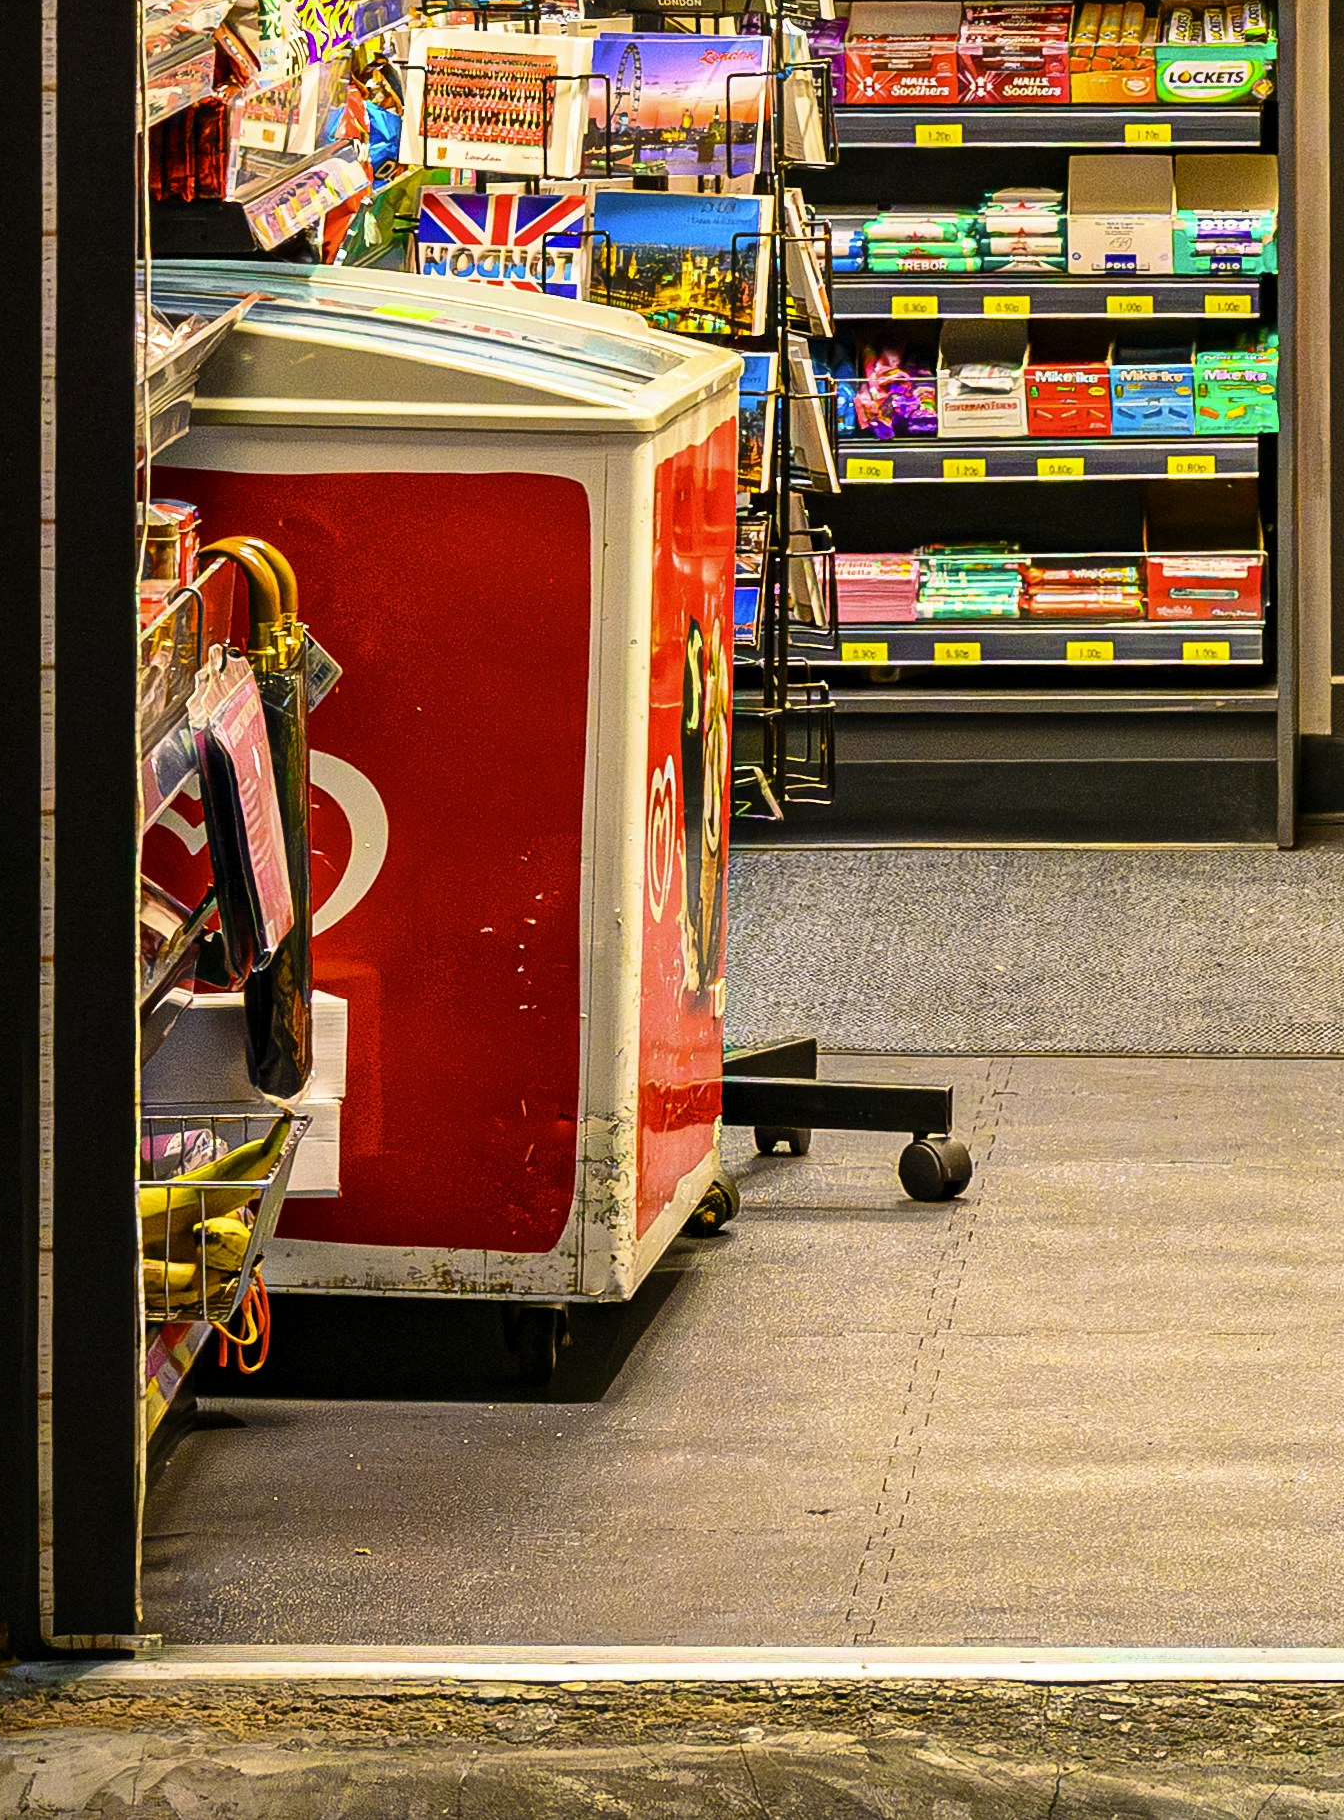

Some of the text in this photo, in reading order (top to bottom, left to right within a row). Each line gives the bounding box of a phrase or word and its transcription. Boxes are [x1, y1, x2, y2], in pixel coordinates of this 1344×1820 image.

[698, 48, 758, 65] London
[900, 76, 938, 86] HALLS
[1012, 76, 1050, 86] HALLS
[890, 84, 950, 97] Soothers
[1001, 84, 1062, 98] Soothers
[895, 260, 948, 271] TREBOR
[1106, 261, 1135, 271] POLO
[1210, 262, 1241, 271] POLO
[1034, 371, 1072, 384] Mike
[1119, 369, 1157, 382] Mike
[1203, 369, 1242, 382] Mike
